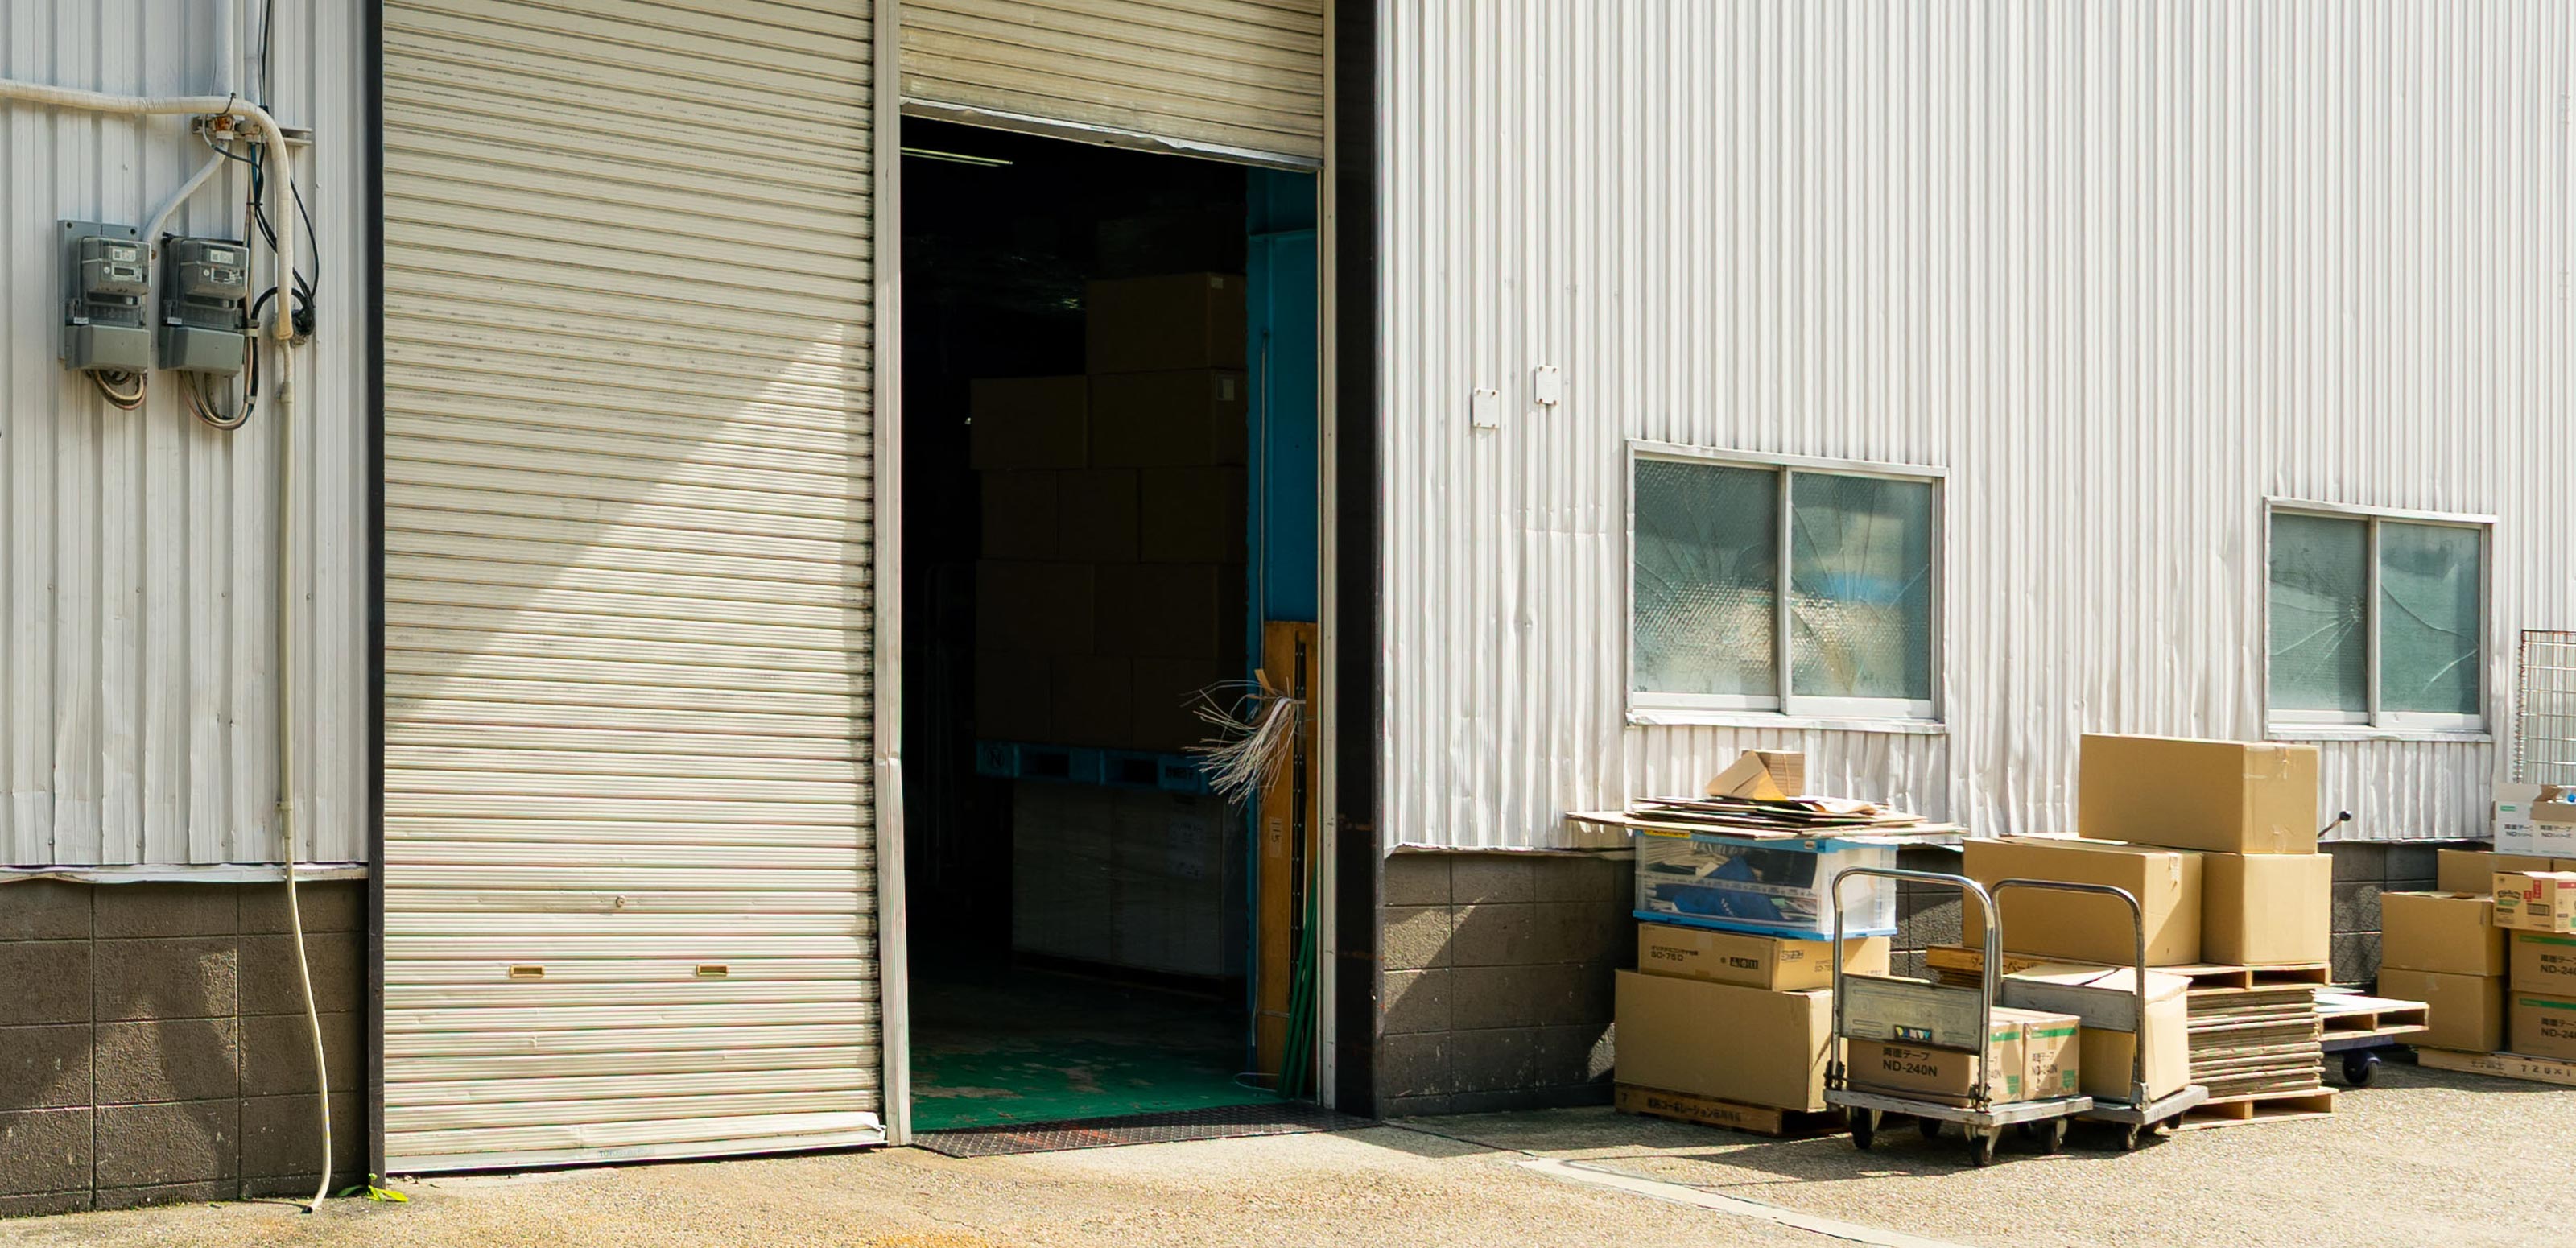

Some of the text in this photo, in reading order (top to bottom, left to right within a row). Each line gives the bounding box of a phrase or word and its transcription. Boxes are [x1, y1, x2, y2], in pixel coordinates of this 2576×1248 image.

[1882, 1047, 1930, 1060] 両面テープ
[1882, 1060, 1938, 1077] ND-240N
